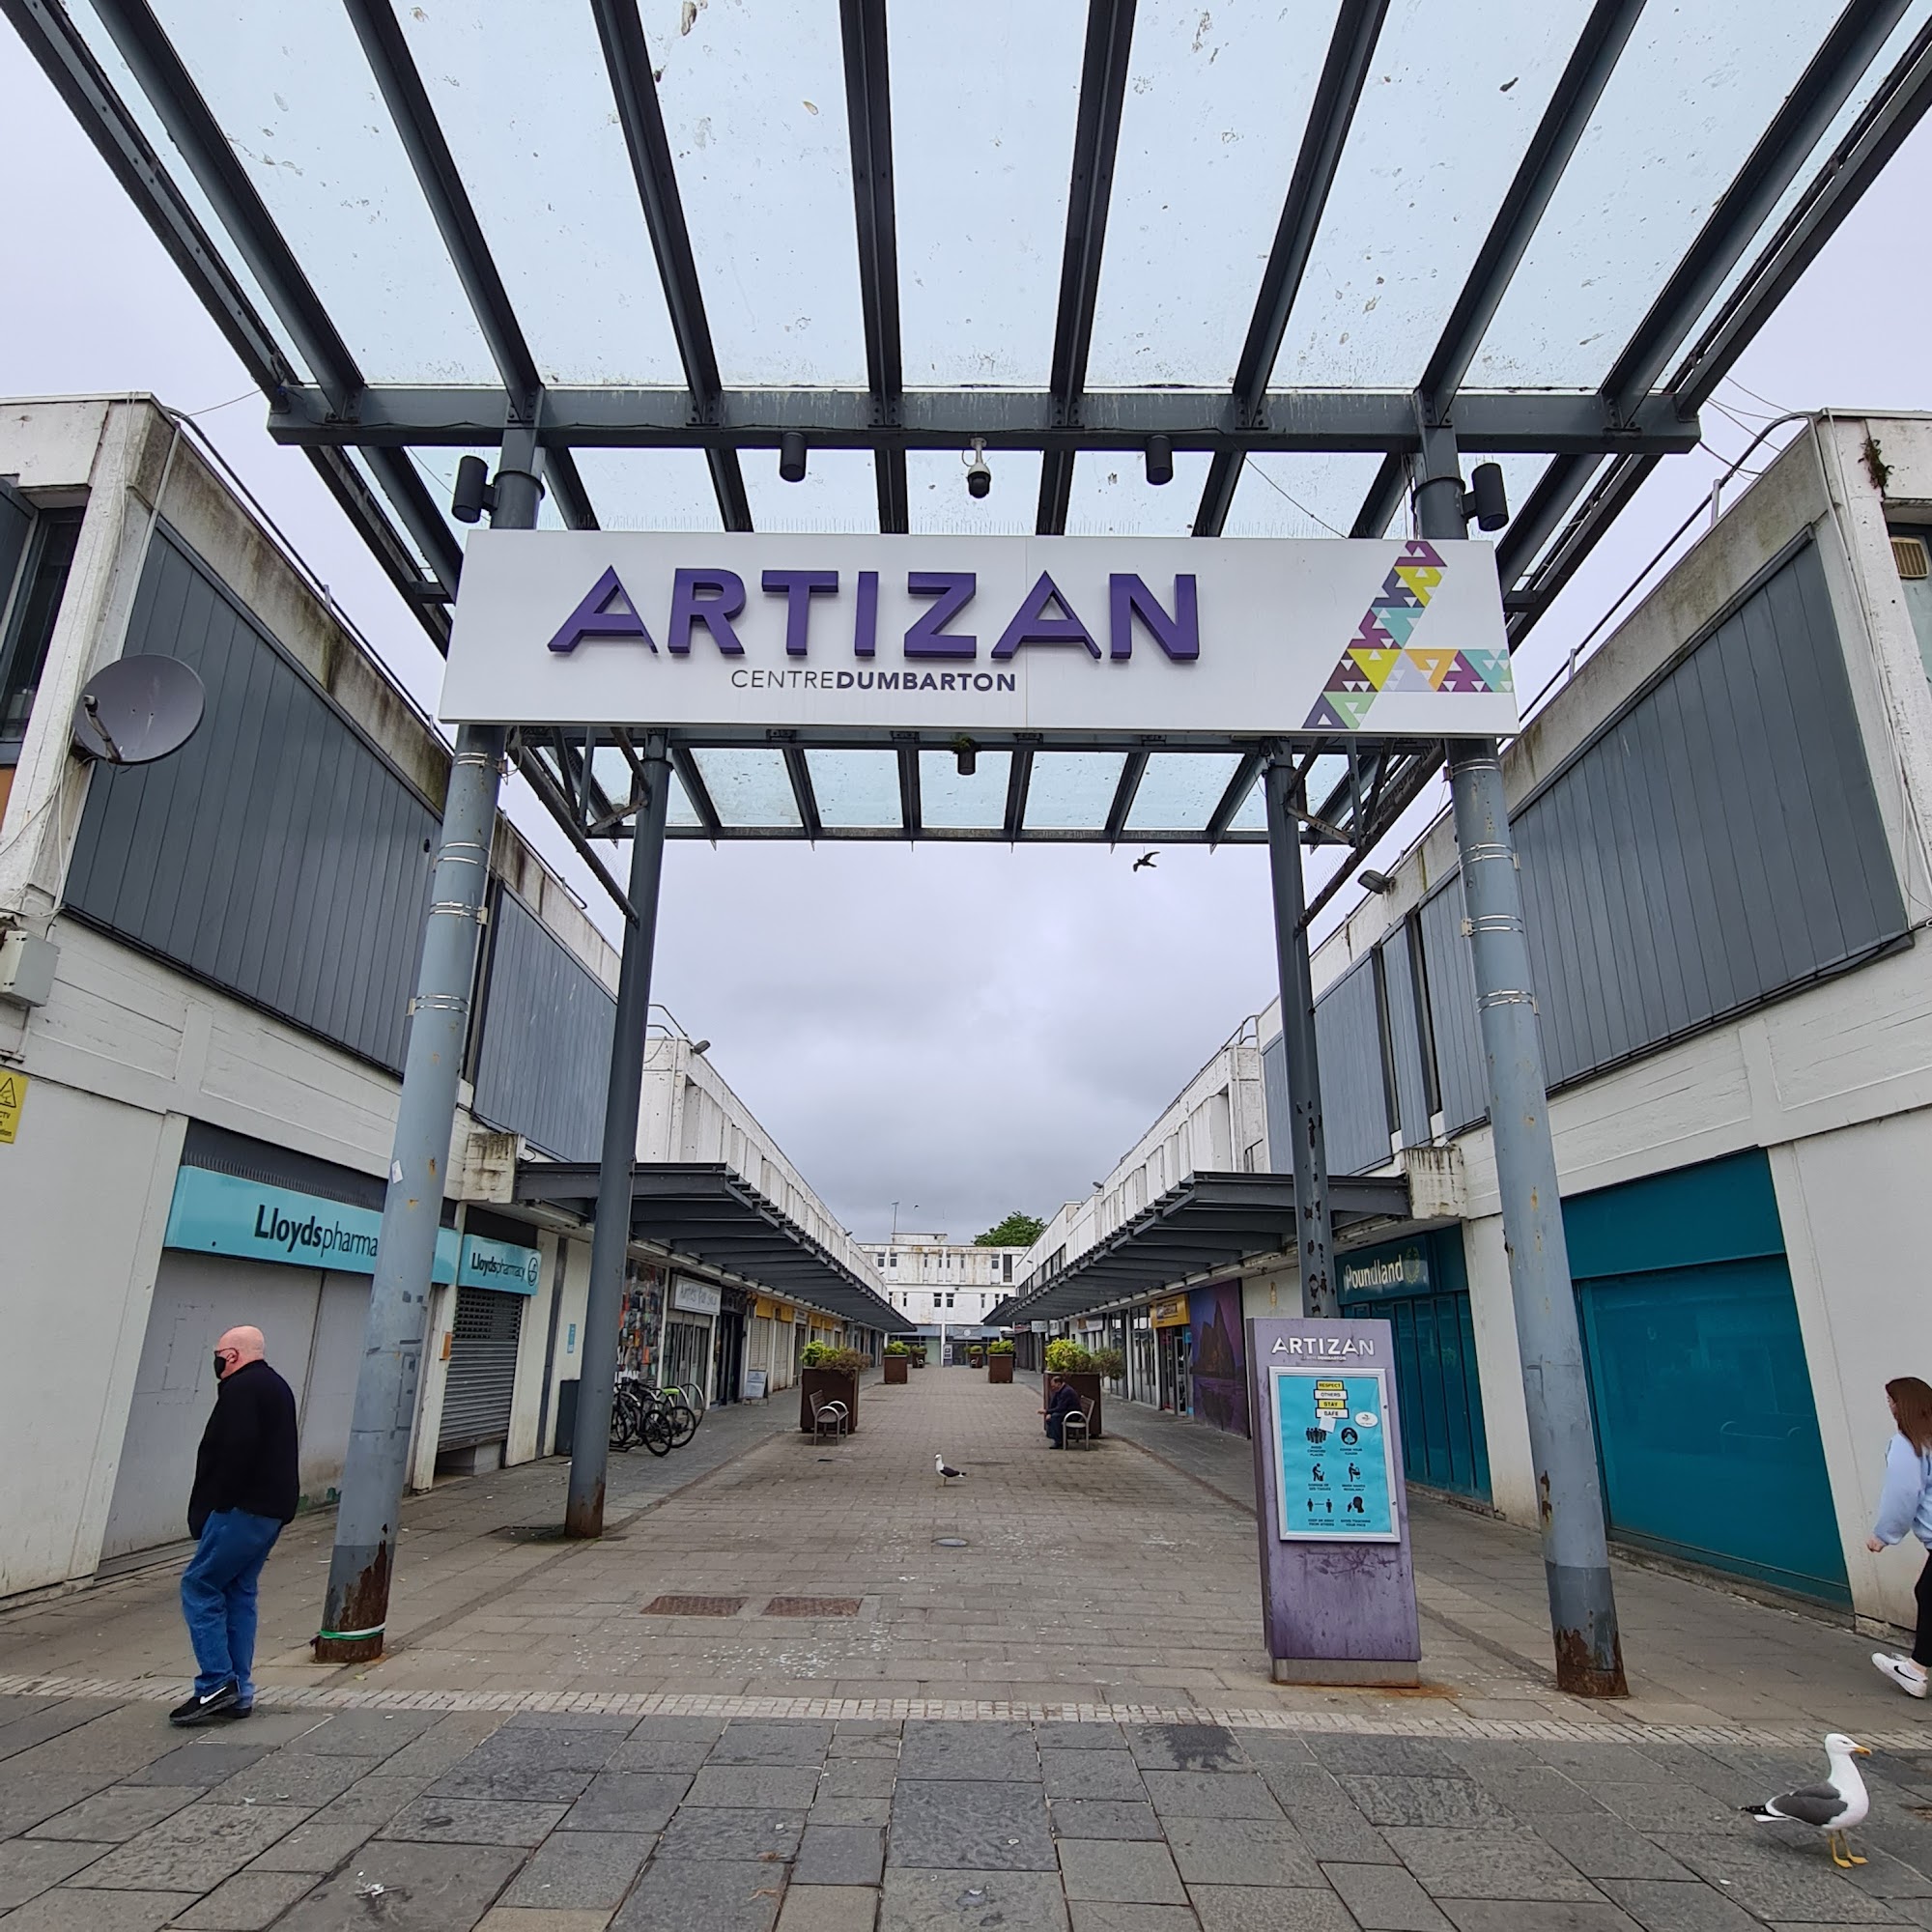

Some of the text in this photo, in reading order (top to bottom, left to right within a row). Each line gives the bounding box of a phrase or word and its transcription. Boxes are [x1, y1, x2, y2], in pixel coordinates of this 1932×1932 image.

[548, 563, 1200, 664] ARTIZAN
[254, 1204, 379, 1258] Lloydspharma
[471, 1252, 526, 1283] Lloydspharmacy
[1345, 1254, 1404, 1290] Poundland
[1271, 1337, 1376, 1356] ARTIZAN
